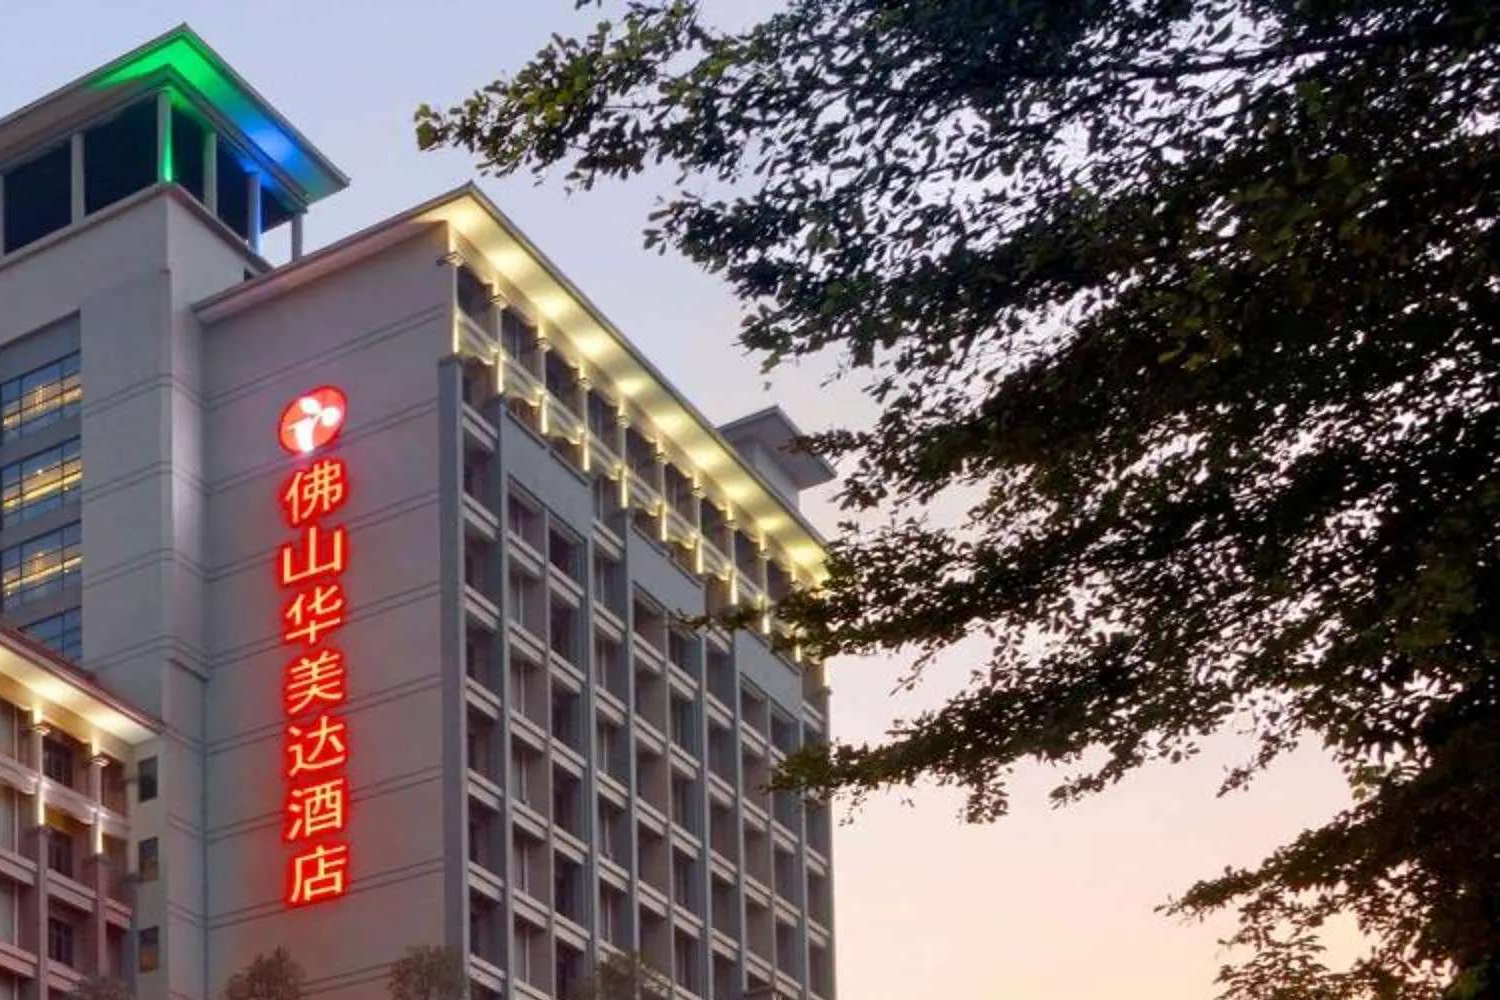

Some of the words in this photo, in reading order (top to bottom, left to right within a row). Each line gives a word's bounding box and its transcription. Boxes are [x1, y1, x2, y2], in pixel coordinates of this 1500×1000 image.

[282, 460, 346, 903] 佛山华美达酒店
